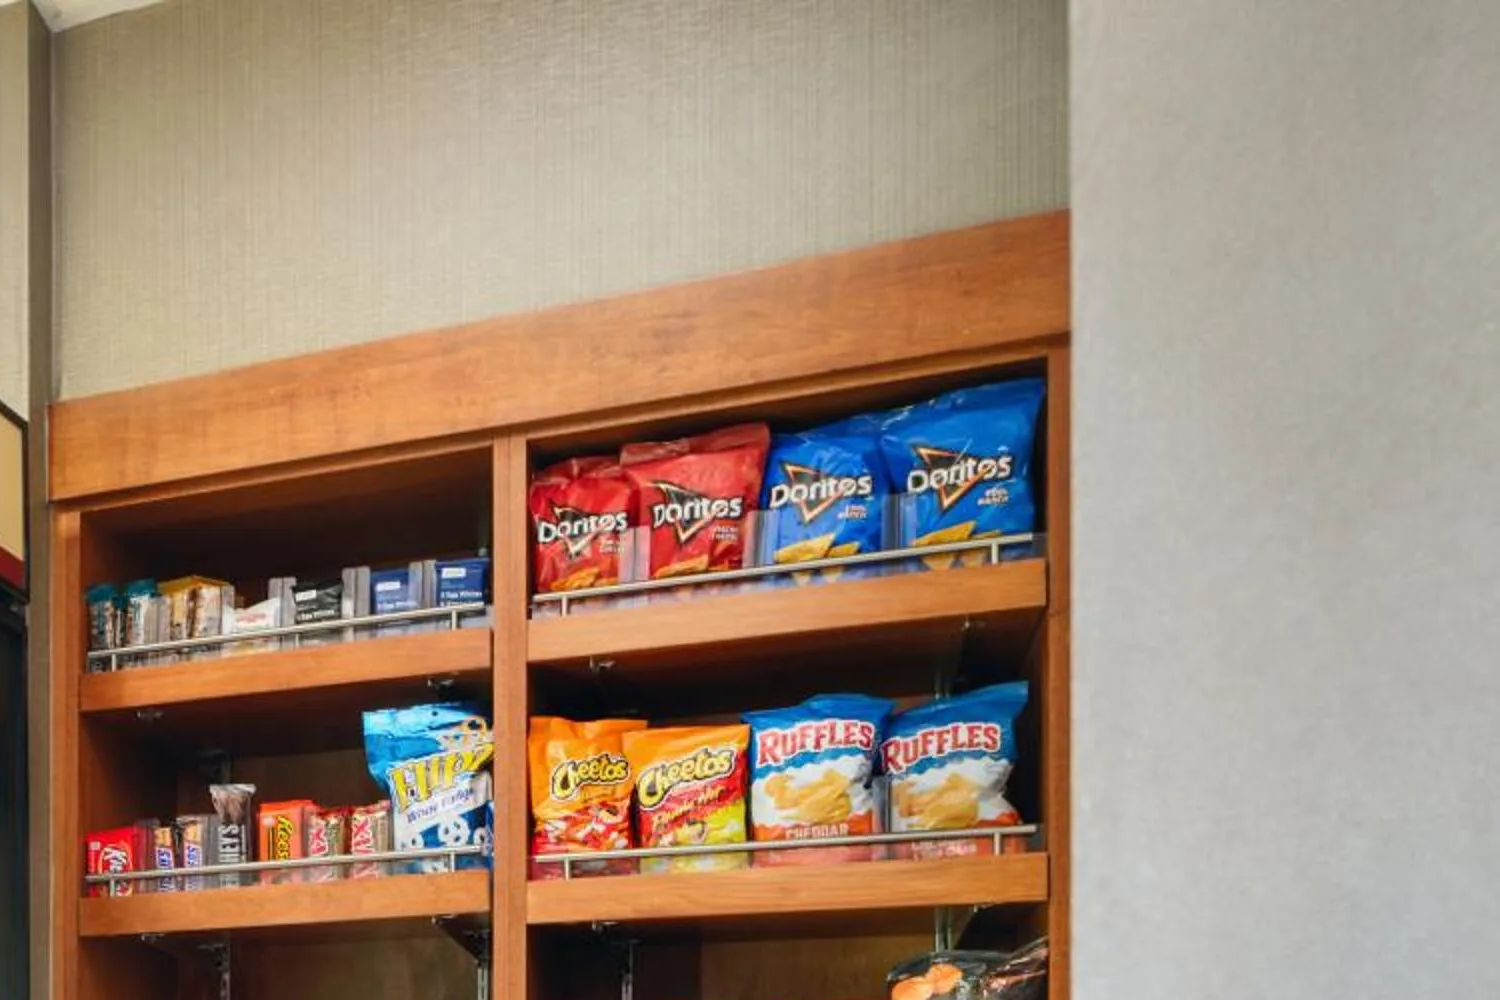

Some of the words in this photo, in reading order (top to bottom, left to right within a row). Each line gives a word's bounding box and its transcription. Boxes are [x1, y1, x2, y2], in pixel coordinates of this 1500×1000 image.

[770, 475, 873, 509] Doritos
[907, 455, 1013, 493] Doritos
[537, 511, 629, 543] Doritos
[653, 497, 743, 528] Doritos
[758, 720, 874, 765] RUFFLES
[882, 723, 1000, 771] RUFFLES
[553, 754, 629, 799] Cheetos
[638, 748, 735, 808] Cheetos
